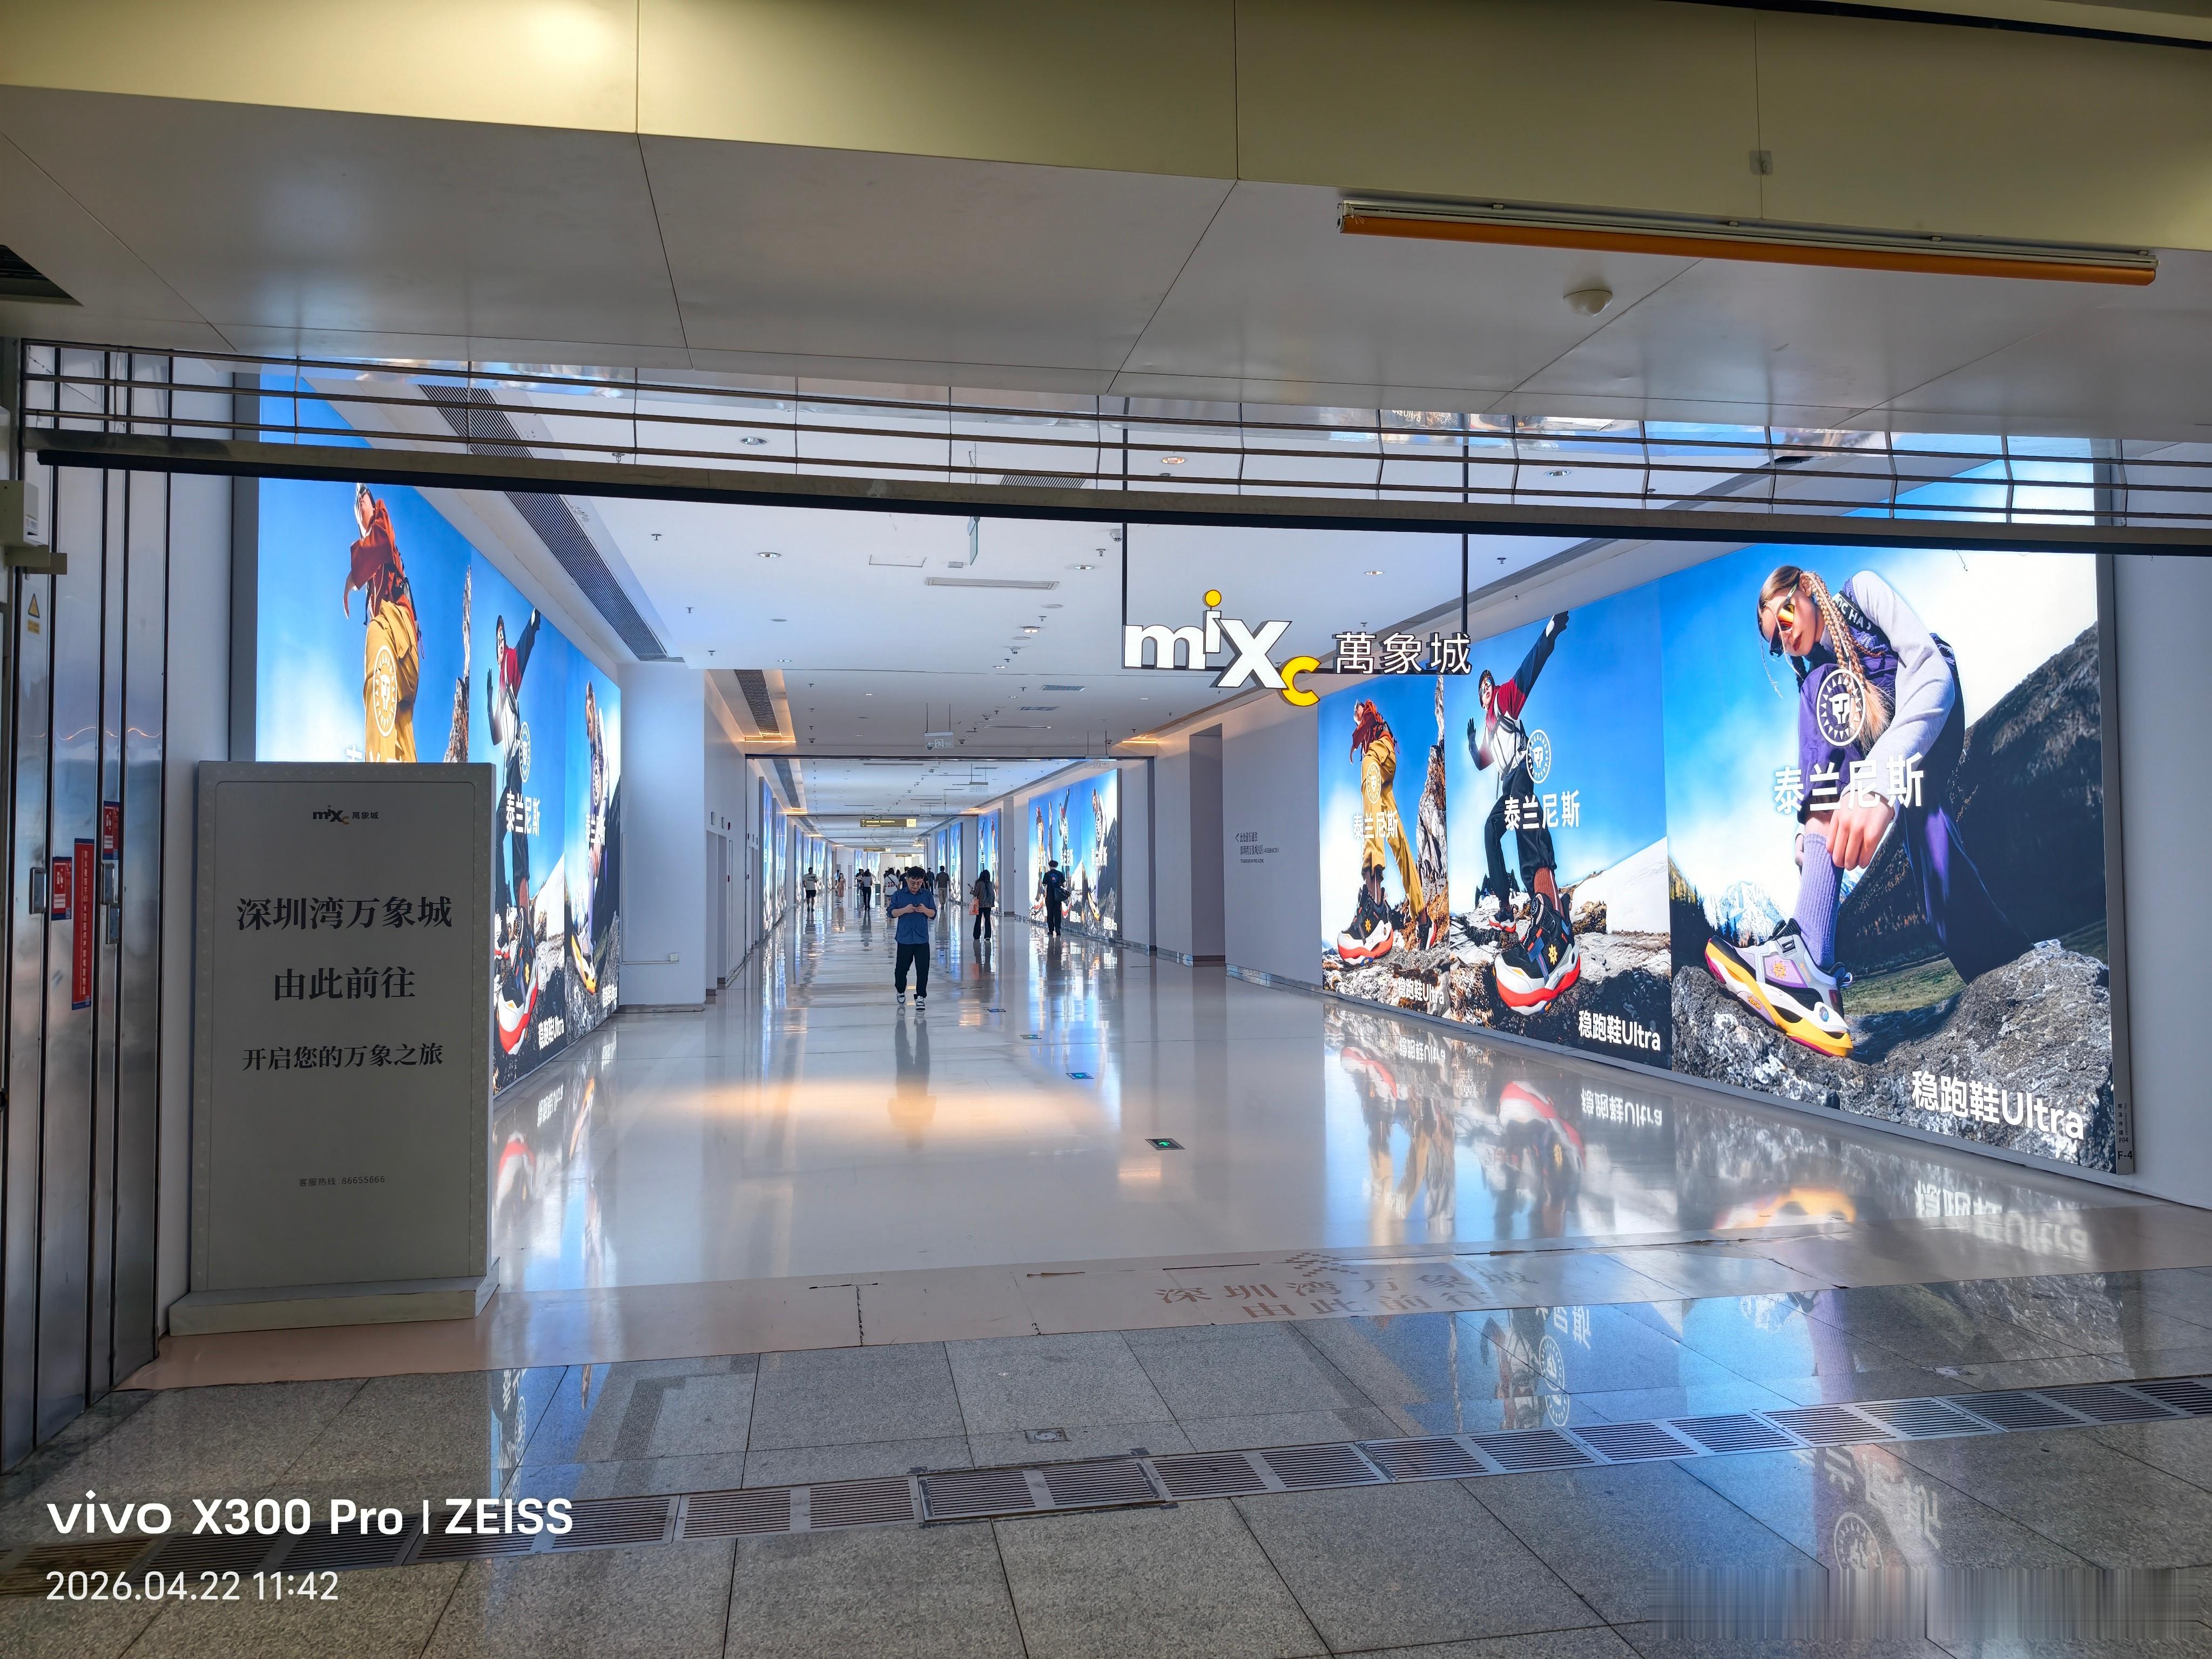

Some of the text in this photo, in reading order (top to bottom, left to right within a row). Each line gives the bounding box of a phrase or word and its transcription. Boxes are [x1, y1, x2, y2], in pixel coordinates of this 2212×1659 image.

[1333, 632, 1472, 675] 萬象城
[1774, 752, 1924, 814] 泰兰尼斯
[507, 788, 540, 837] 泰兰尼斯
[1352, 809, 1398, 840] 泰兰尼斯
[1504, 790, 1580, 831] 泰兰尼斯
[237, 896, 453, 931] 深圳湾万象城
[273, 966, 416, 1002] 由此前往
[1398, 977, 1445, 1005] 稳跑鞋Ultra
[1578, 1009, 1661, 1051] 稳跑鞋Ultra
[242, 1042, 443, 1071] 开启您的万象之旅
[1912, 1070, 2083, 1140] 稳跑鞋Ultra
[2117, 1151, 2133, 1159] F-4
